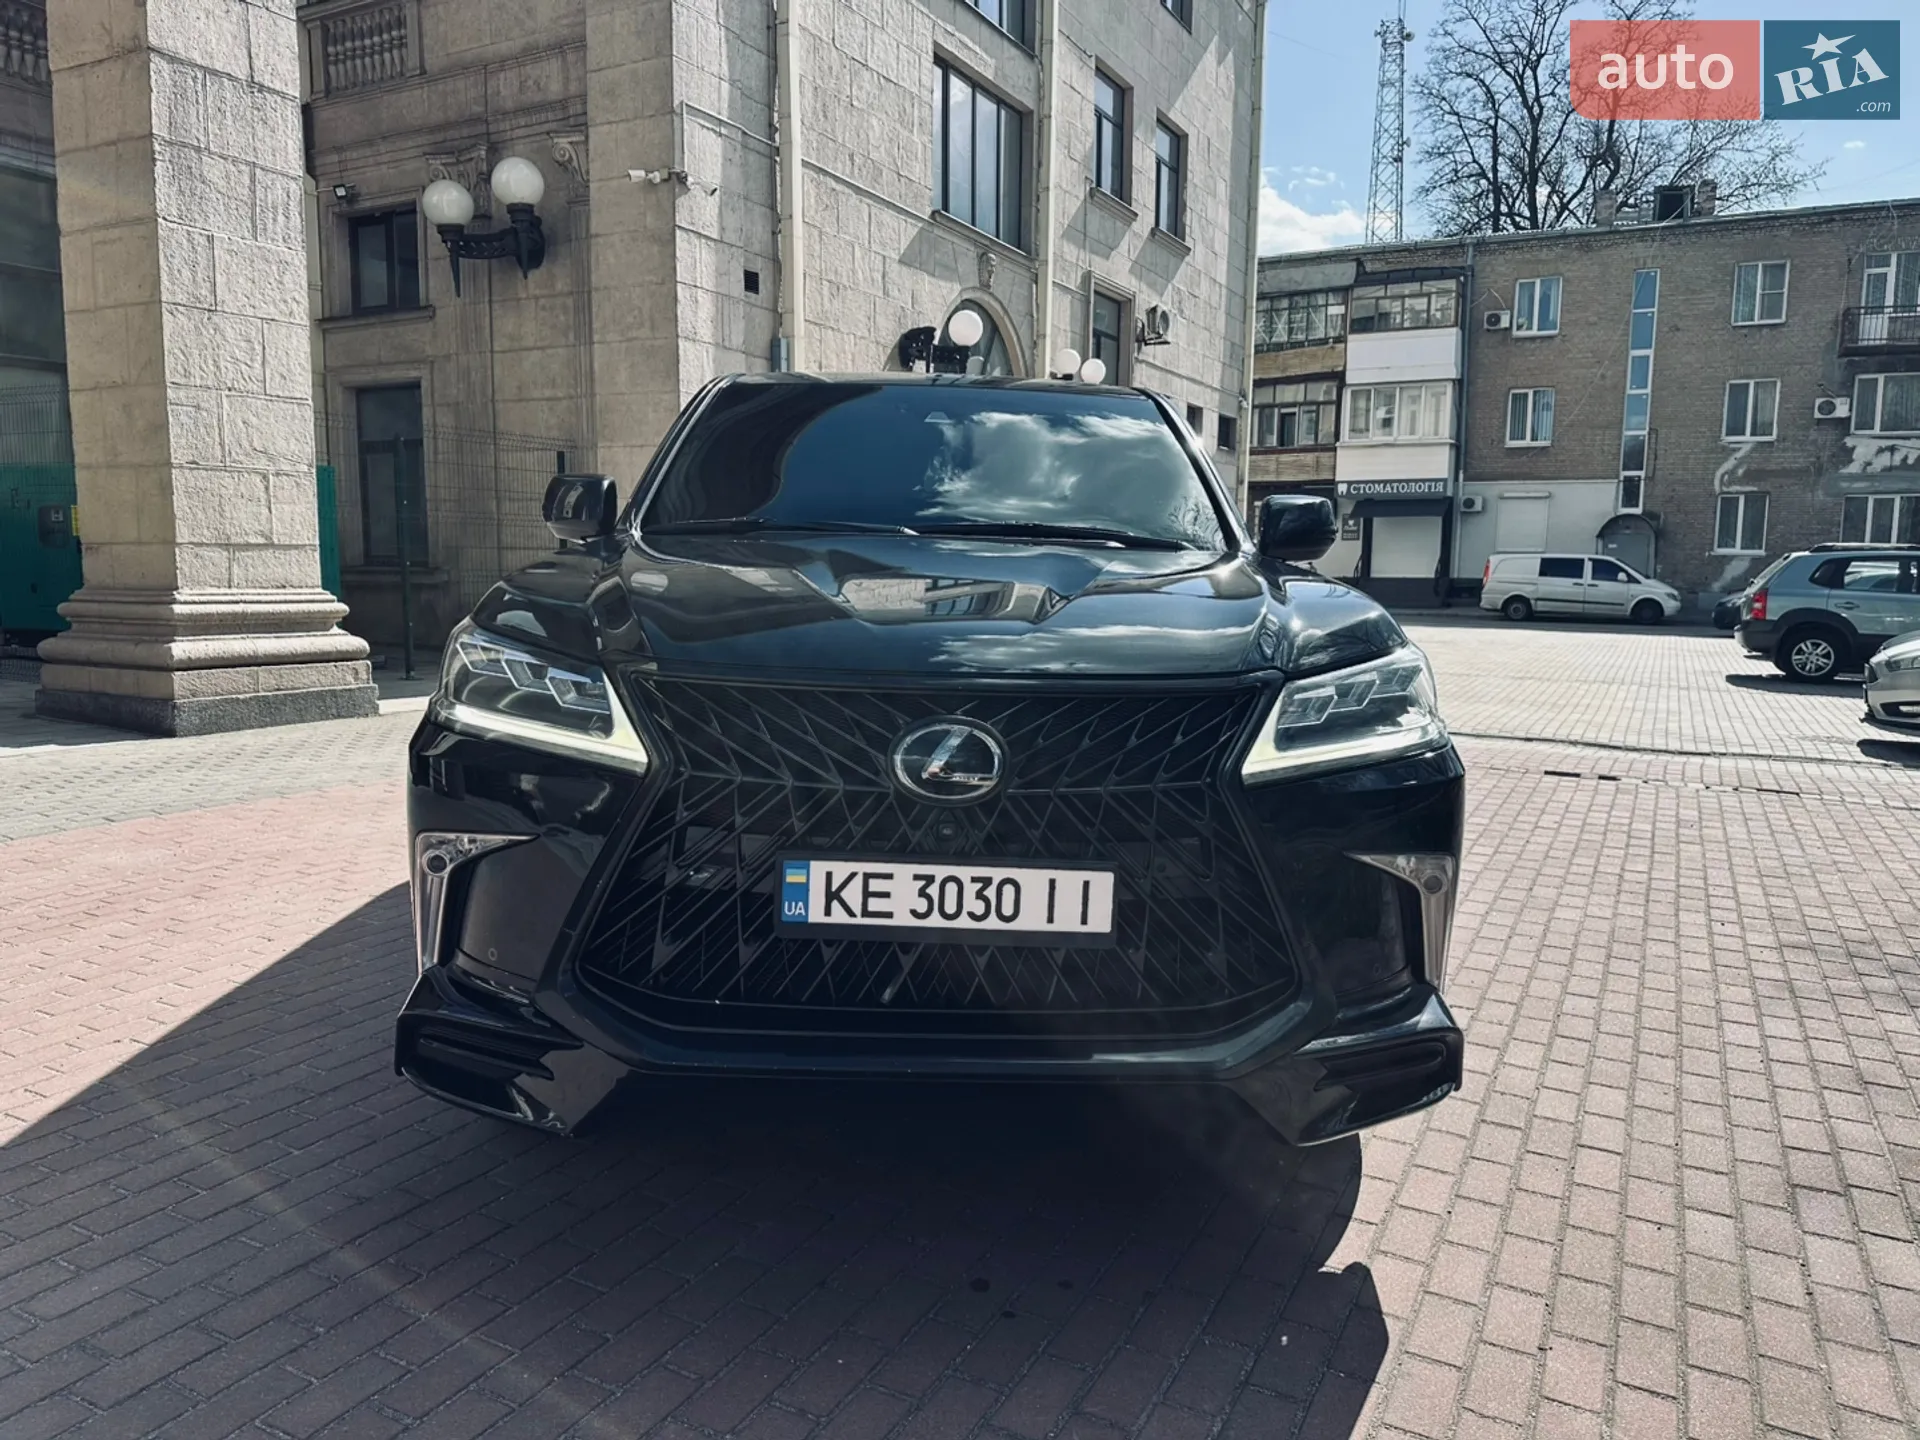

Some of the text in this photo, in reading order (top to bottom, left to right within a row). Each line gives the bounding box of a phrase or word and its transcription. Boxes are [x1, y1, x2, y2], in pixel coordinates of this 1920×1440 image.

[1350, 481, 1444, 494] СТОМАТОЛОГІЯ
[824, 871, 894, 919] KE
[909, 873, 1022, 923] 3030
[784, 901, 806, 916] UA
